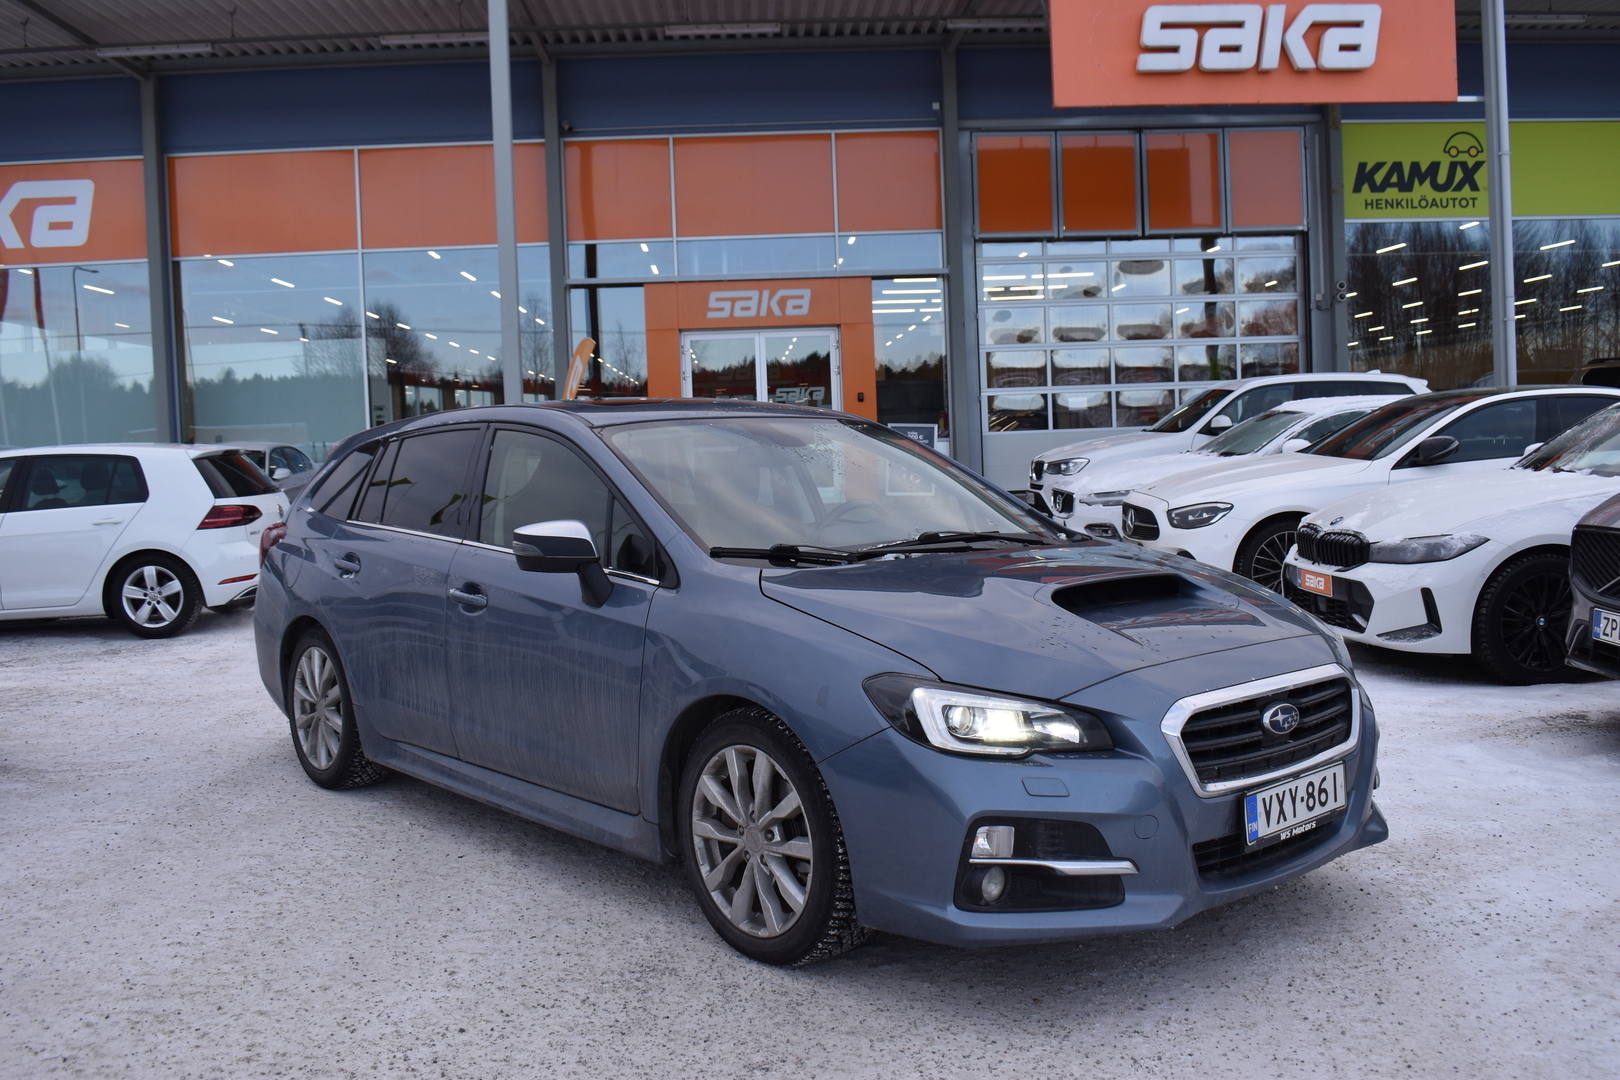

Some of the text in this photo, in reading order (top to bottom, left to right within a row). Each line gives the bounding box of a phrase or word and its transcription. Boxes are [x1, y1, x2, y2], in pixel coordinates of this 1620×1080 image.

[1352, 160, 1486, 193] KAMUX
[1364, 195, 1478, 210] HENKILÖAUTOT
[1602, 616, 1620, 639] ZP
[1261, 772, 1338, 829] VXY-861
[1248, 821, 1258, 834] FIN
[1280, 821, 1317, 841] WS Motors
